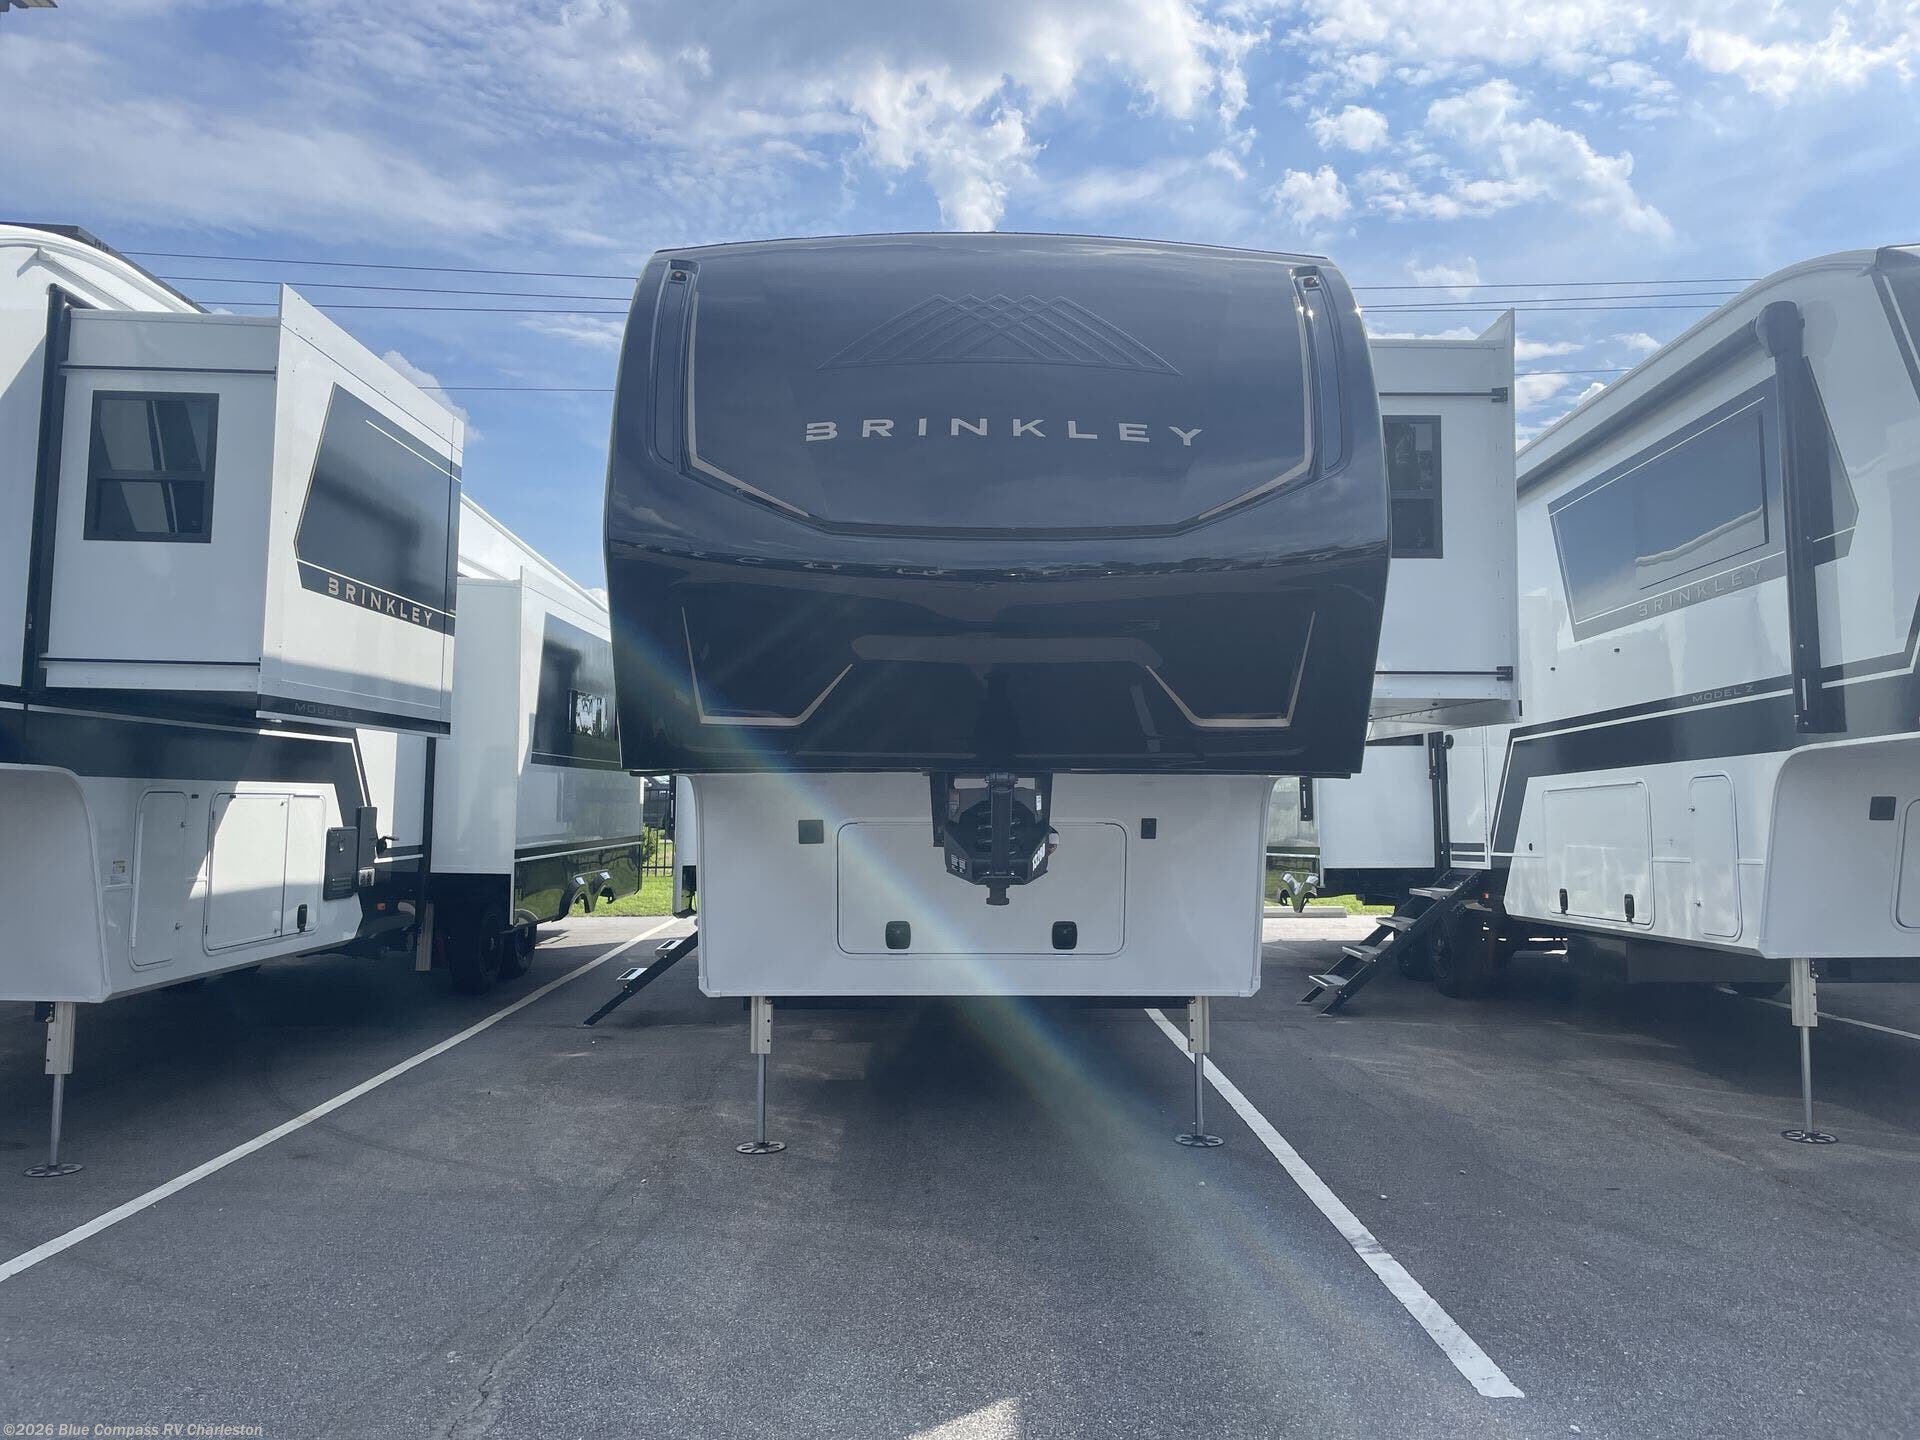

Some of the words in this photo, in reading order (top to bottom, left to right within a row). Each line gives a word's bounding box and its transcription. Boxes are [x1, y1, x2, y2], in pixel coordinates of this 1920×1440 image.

[805, 417, 1202, 446] BRINKLEY
[328, 576, 433, 627] BRINKLEY
[1638, 565, 1761, 617] BRINKLEY
[1692, 687, 1741, 703] MODEL
